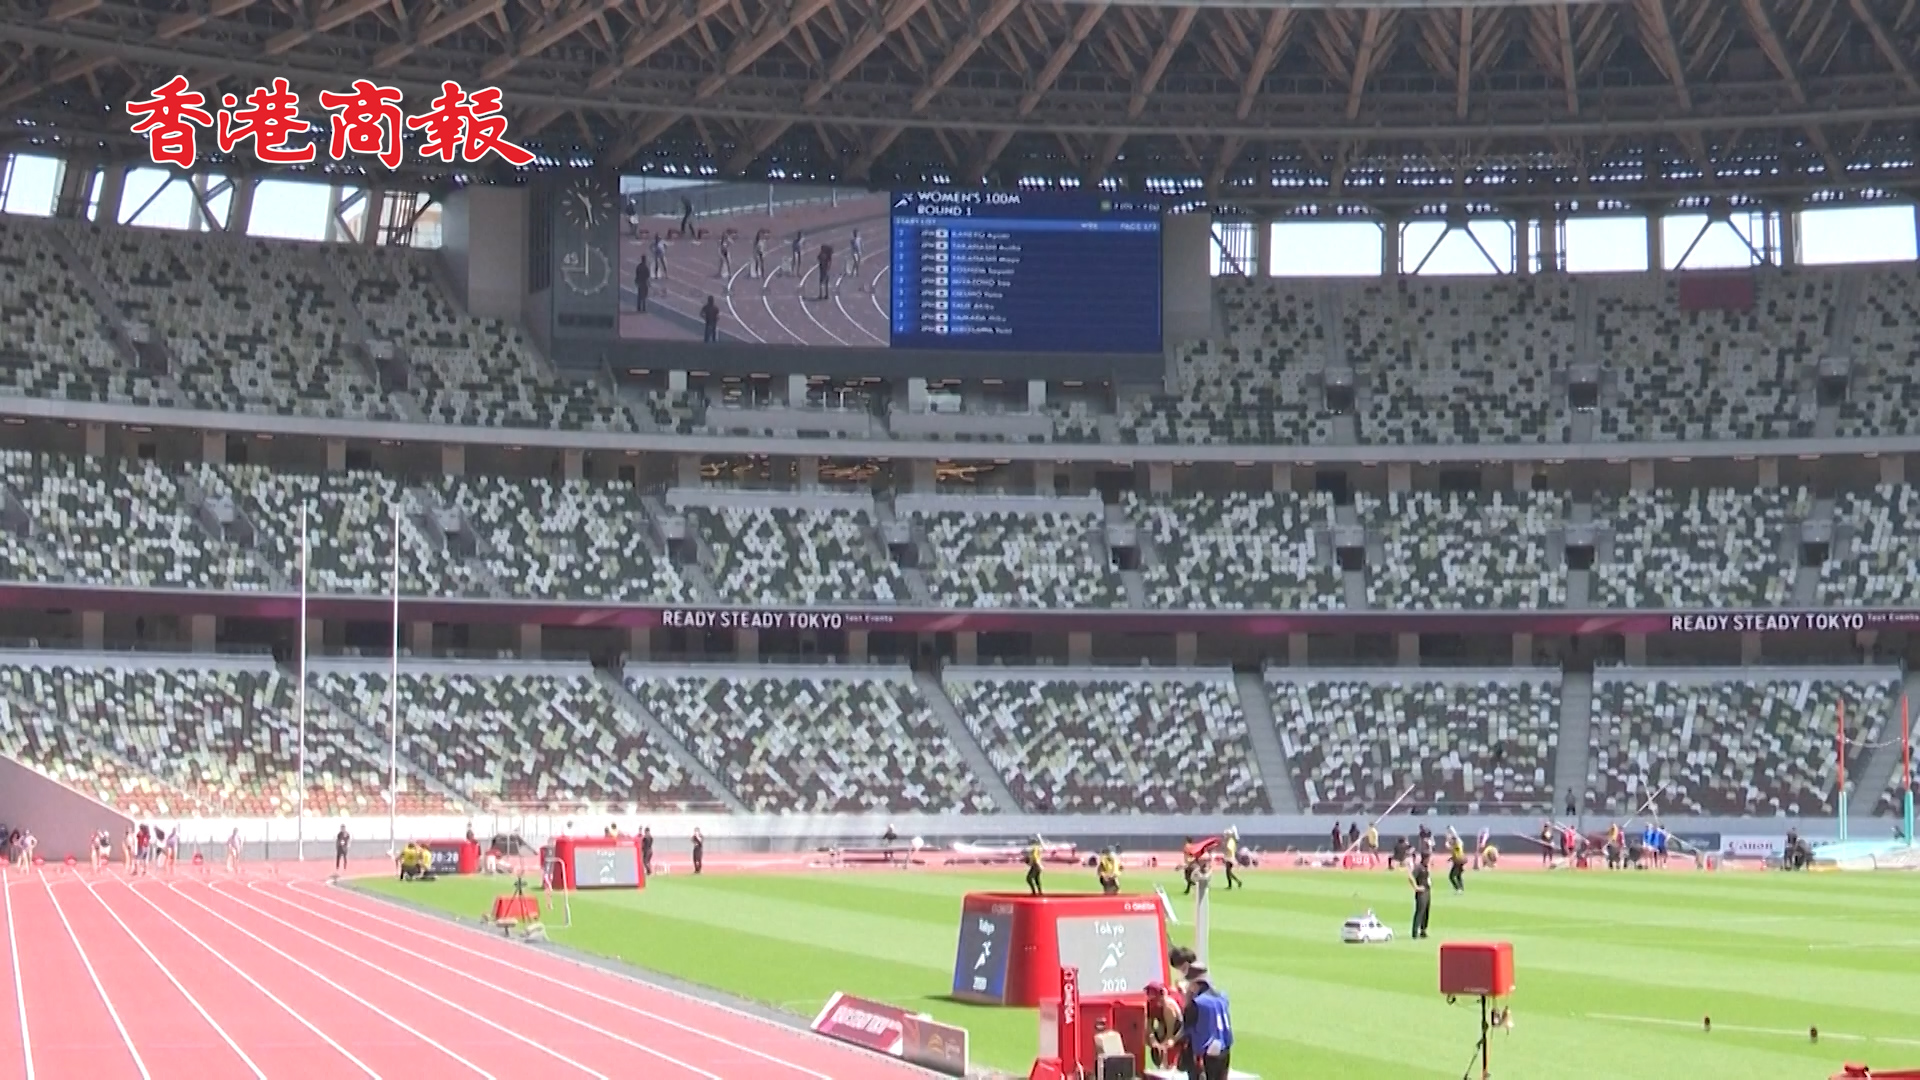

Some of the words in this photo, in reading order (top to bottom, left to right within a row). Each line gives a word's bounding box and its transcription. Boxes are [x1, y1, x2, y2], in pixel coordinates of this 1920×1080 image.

[917, 191, 981, 204] WOMEN'S
[985, 193, 1021, 205] 100M
[917, 204, 962, 216] ROUND
[966, 206, 972, 216] 1
[662, 610, 716, 627] READY
[720, 611, 783, 628] STEADY
[788, 613, 842, 629] TOKYO
[1672, 614, 1728, 632] READY
[1733, 613, 1800, 631] STEADY
[1805, 612, 1864, 630] TOKYO
[1867, 613, 1887, 622] Test
[1094, 920, 1125, 937] Tokyo
[1101, 977, 1127, 992] 2020
